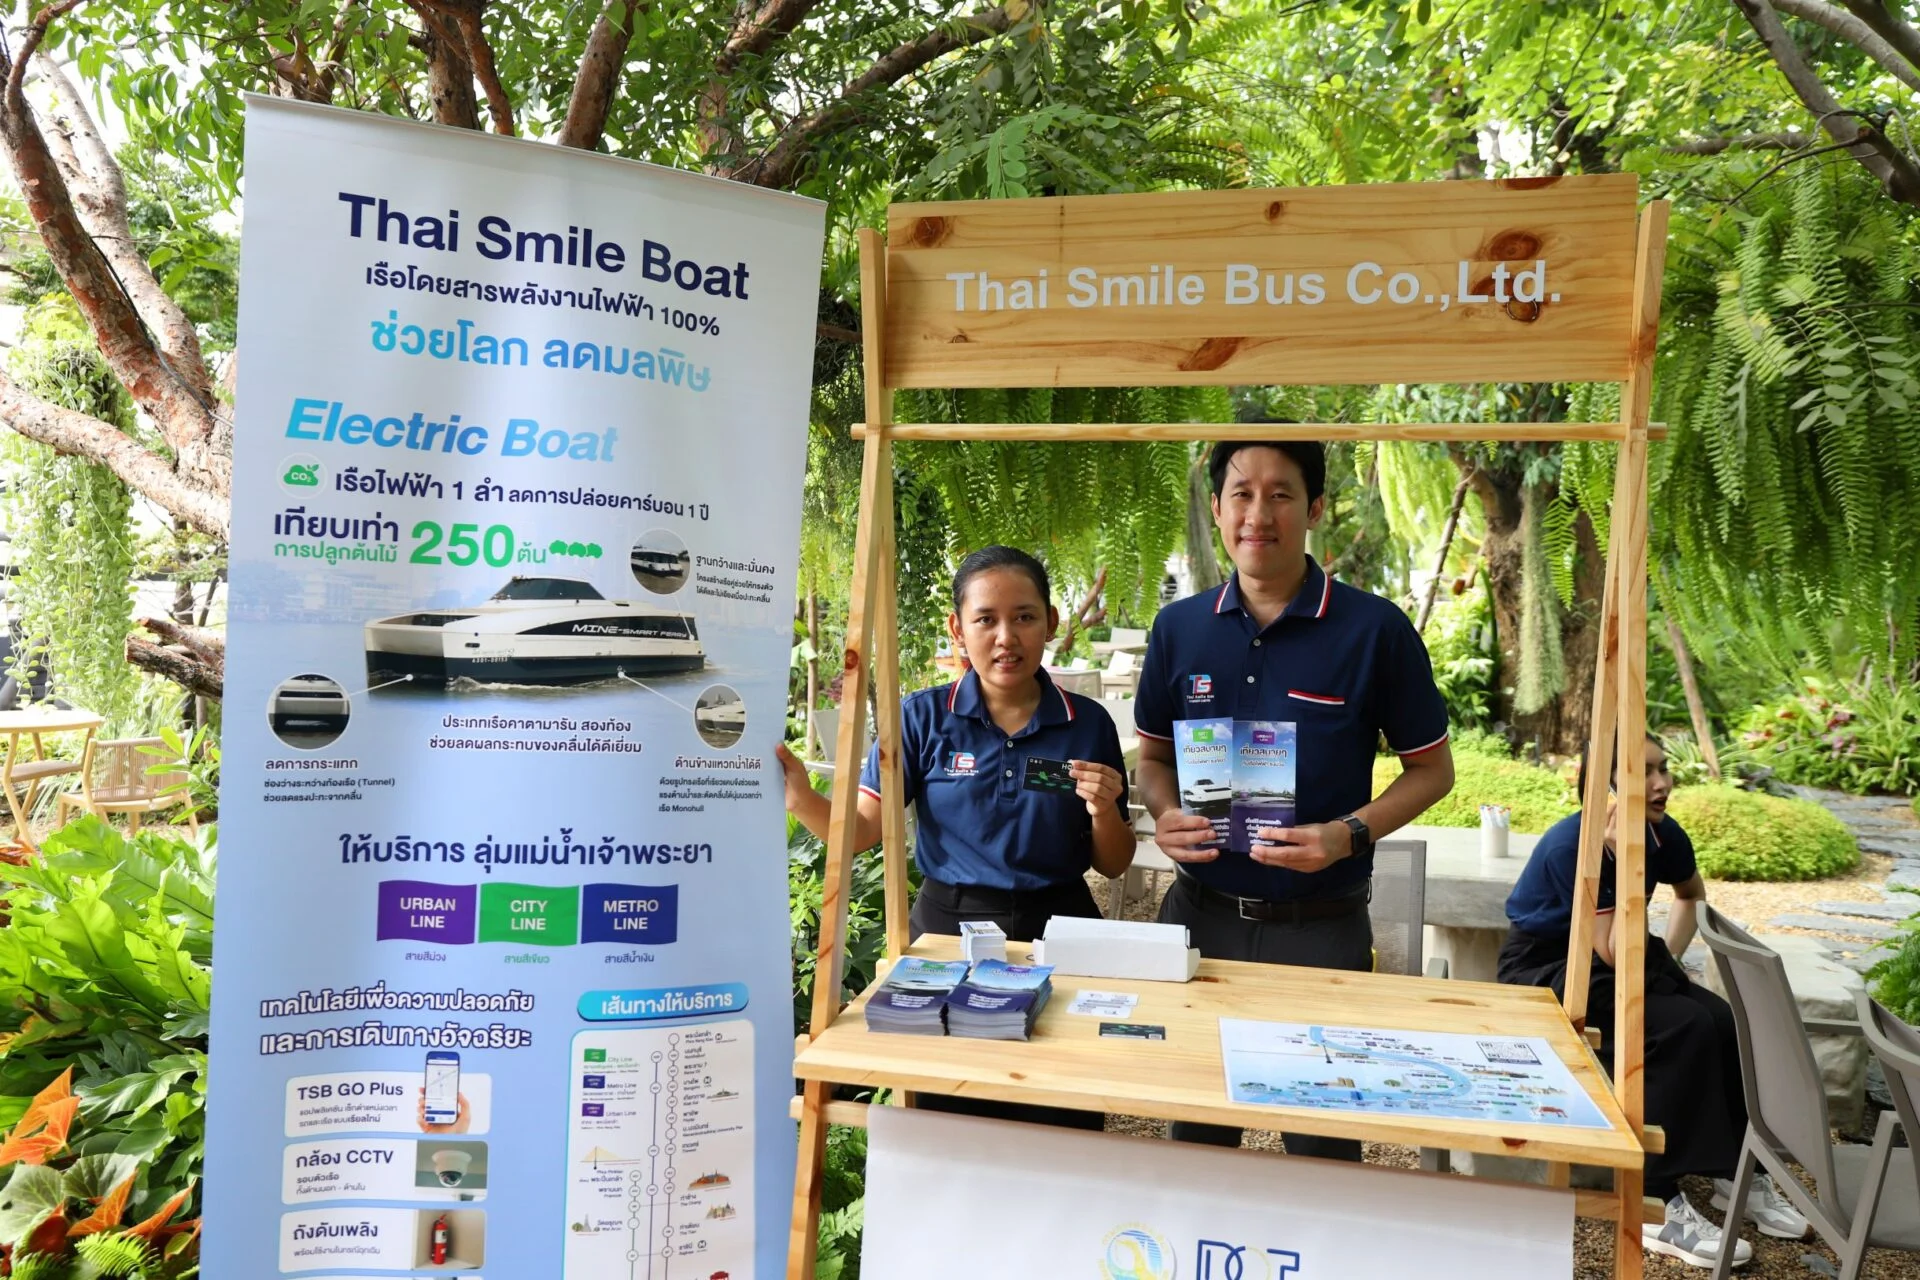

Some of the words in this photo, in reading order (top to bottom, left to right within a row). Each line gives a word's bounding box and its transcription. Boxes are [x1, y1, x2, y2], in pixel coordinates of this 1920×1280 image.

[338, 191, 459, 253] Thai
[475, 215, 626, 273] Smile
[641, 238, 749, 300] Boat
[946, 269, 1048, 311] Thai
[1066, 264, 1206, 308] Smile
[1225, 263, 1326, 306] Bus
[1346, 260, 1561, 313] Co.,Ltd.
[365, 260, 654, 321] เรือโดยสารพลังงานไฟฟ้า
[660, 305, 720, 337] 100%
[371, 310, 529, 367] ช่วยโลก
[542, 336, 712, 393] ลดมลพิษ
[284, 398, 489, 454] Electric
[500, 418, 619, 463] Boat
[335, 466, 443, 500] เรือไฟฟ้า
[453, 480, 464, 500] 1
[474, 477, 504, 503] ลำ
[508, 486, 684, 518] ลดการปล่อยคาร์บอน
[688, 503, 695, 519] 1
[699, 501, 709, 521] ปี
[274, 508, 399, 542] เทียบเท่า
[409, 521, 515, 567] 250
[517, 541, 547, 564] ต้น
[274, 540, 397, 567] การปลูกต้นไม้
[695, 555, 775, 575] ฐานกว้างและมั่นคง
[442, 714, 577, 731] ประเภทเรือคาตามารัน
[581, 718, 631, 732] สองท้อง
[430, 735, 642, 753] ช่วยลดผลกระทบของคลื่นได้ดีเยี่ยม
[265, 759, 358, 770] ลดการกระแทก
[358, 778, 395, 787] (Tunnel)
[339, 833, 465, 864] ให้บริการ
[473, 827, 713, 874] ลุ่มแม่น้ำเจ้าพระยา
[399, 897, 456, 911] URBAN
[510, 900, 548, 913] CITY
[603, 899, 659, 913] METRO
[410, 915, 445, 928] LINE
[511, 918, 546, 931] LINE
[614, 917, 648, 930] LINE
[405, 949, 447, 962] สายสีม่วง
[260, 980, 534, 1018] เทคโนโลยีเพื่อความปลอดภัย
[602, 992, 733, 1015] เส้นทางให้บริการ
[260, 1020, 532, 1055] และการเดินทางอัจฉริยะ
[297, 1084, 332, 1100] TSB
[338, 1083, 364, 1096] GO
[370, 1082, 403, 1096] Plus
[296, 1150, 341, 1168] กล้อง
[346, 1150, 394, 1165] CCTV
[293, 1221, 378, 1240] ถังดับเพลิง
